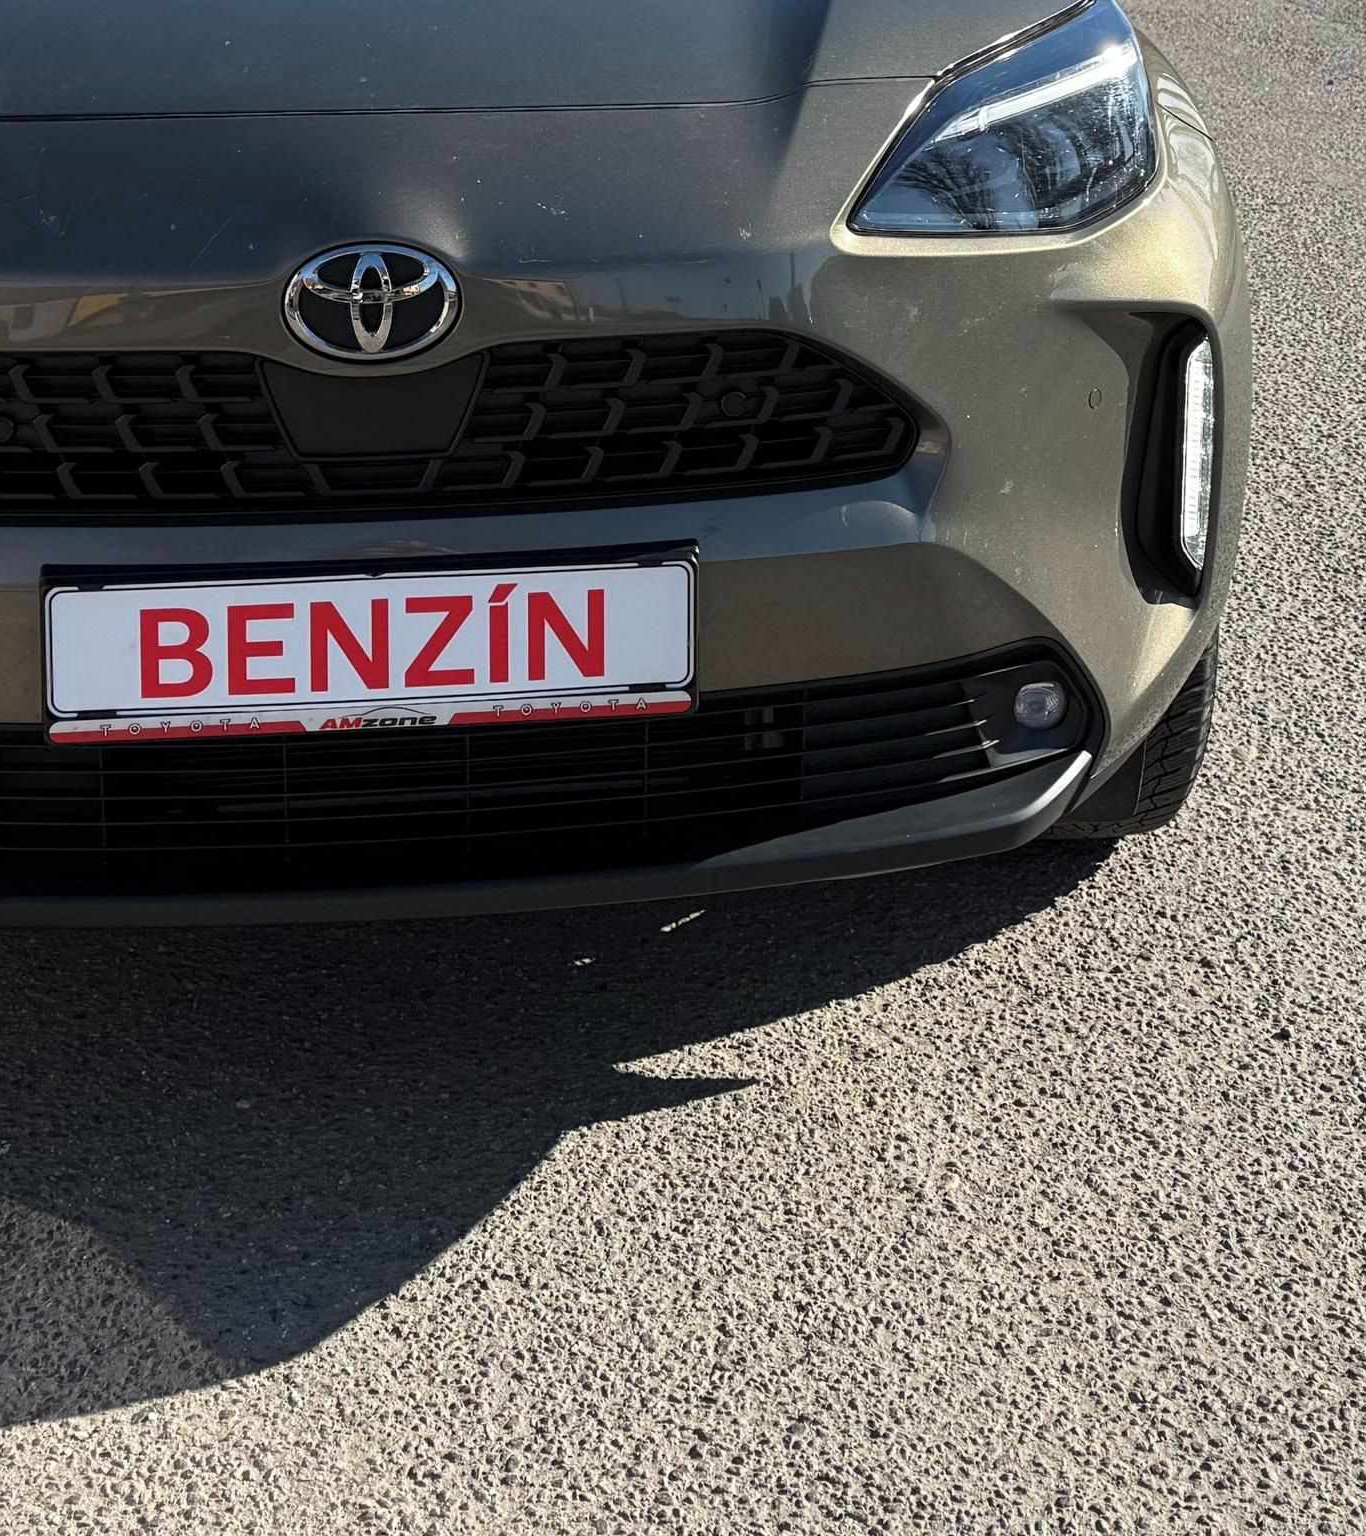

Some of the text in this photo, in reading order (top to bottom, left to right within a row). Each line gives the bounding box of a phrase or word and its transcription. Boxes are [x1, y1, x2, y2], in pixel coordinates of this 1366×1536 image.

[139, 582, 607, 699] BENZÍN
[100, 697, 647, 737] TOYOTA AMzone TOYOTA
